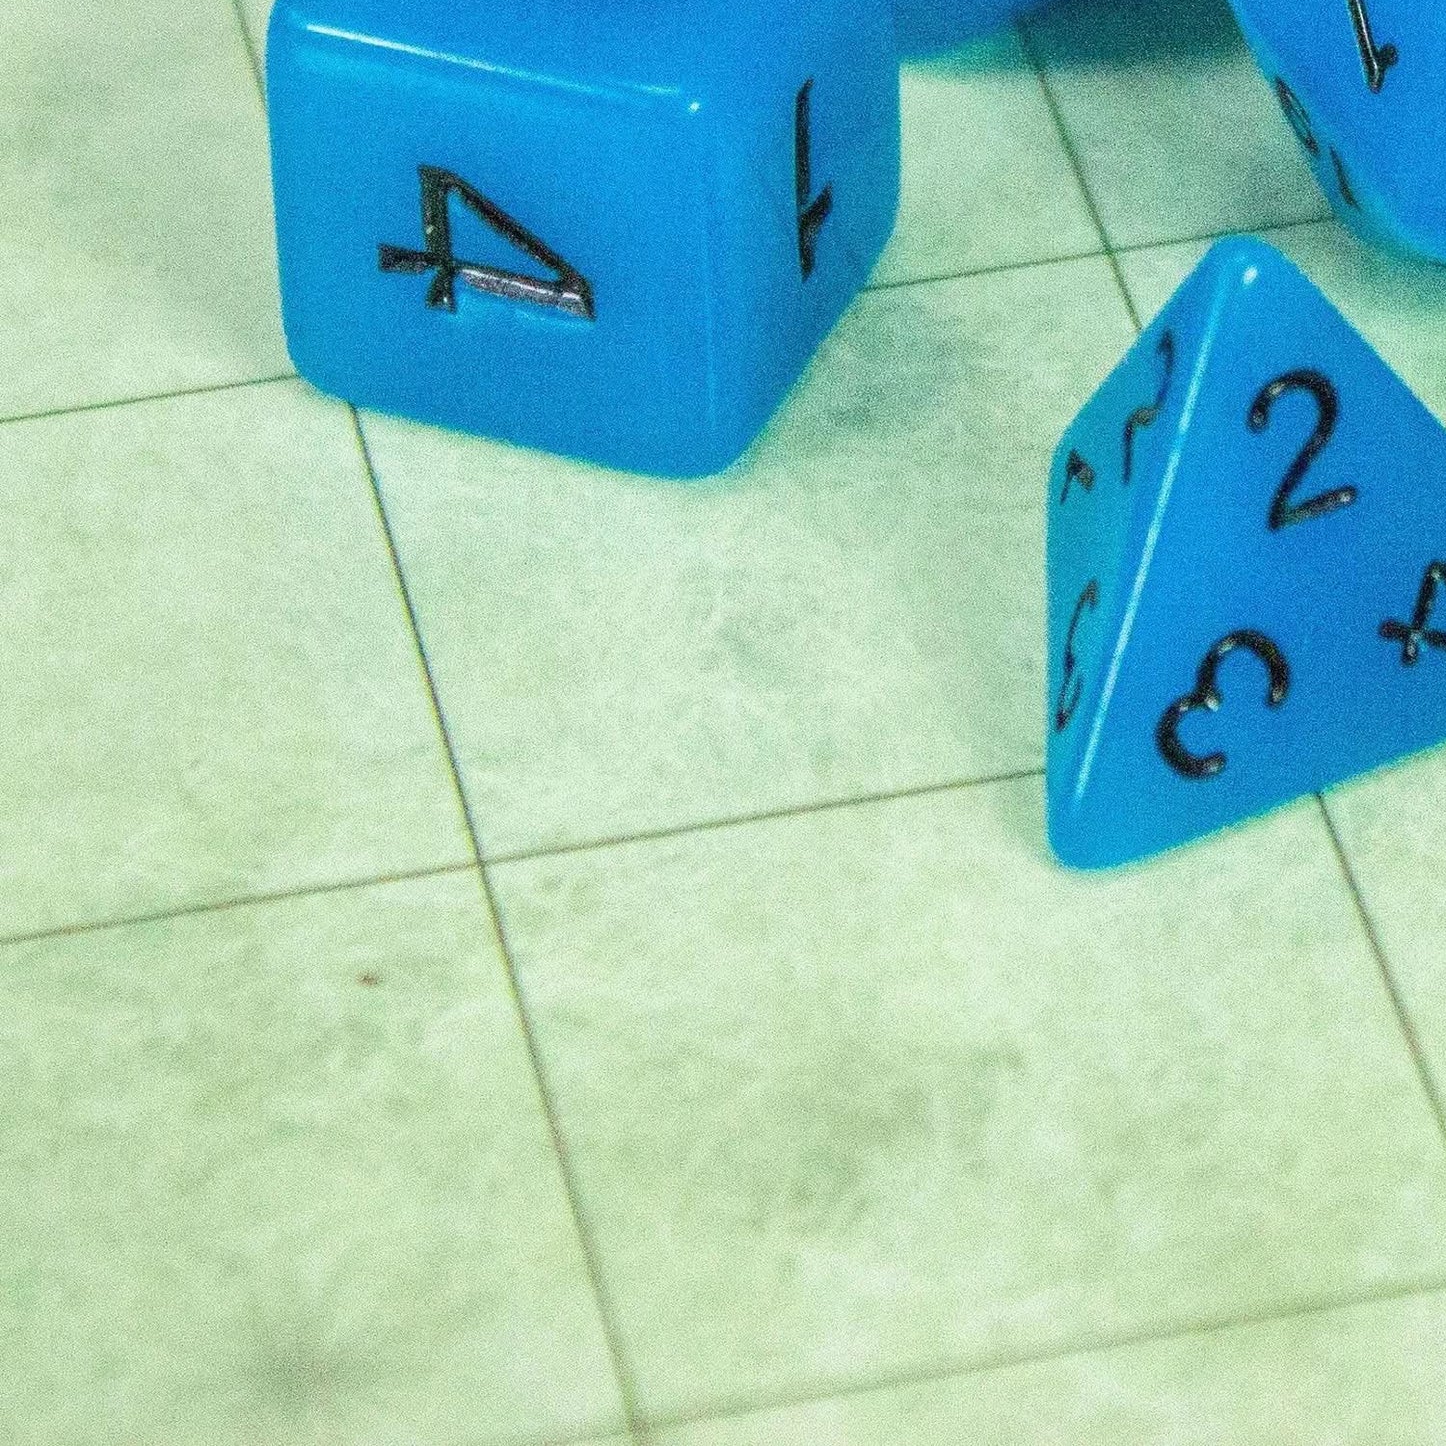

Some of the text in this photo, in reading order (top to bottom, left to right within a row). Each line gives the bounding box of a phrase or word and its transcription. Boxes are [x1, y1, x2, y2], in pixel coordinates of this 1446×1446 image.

[380, 166, 594, 318] 4
[795, 83, 831, 277] 1
[1249, 370, 1356, 530] 2
[1157, 630, 1290, 779] 3
